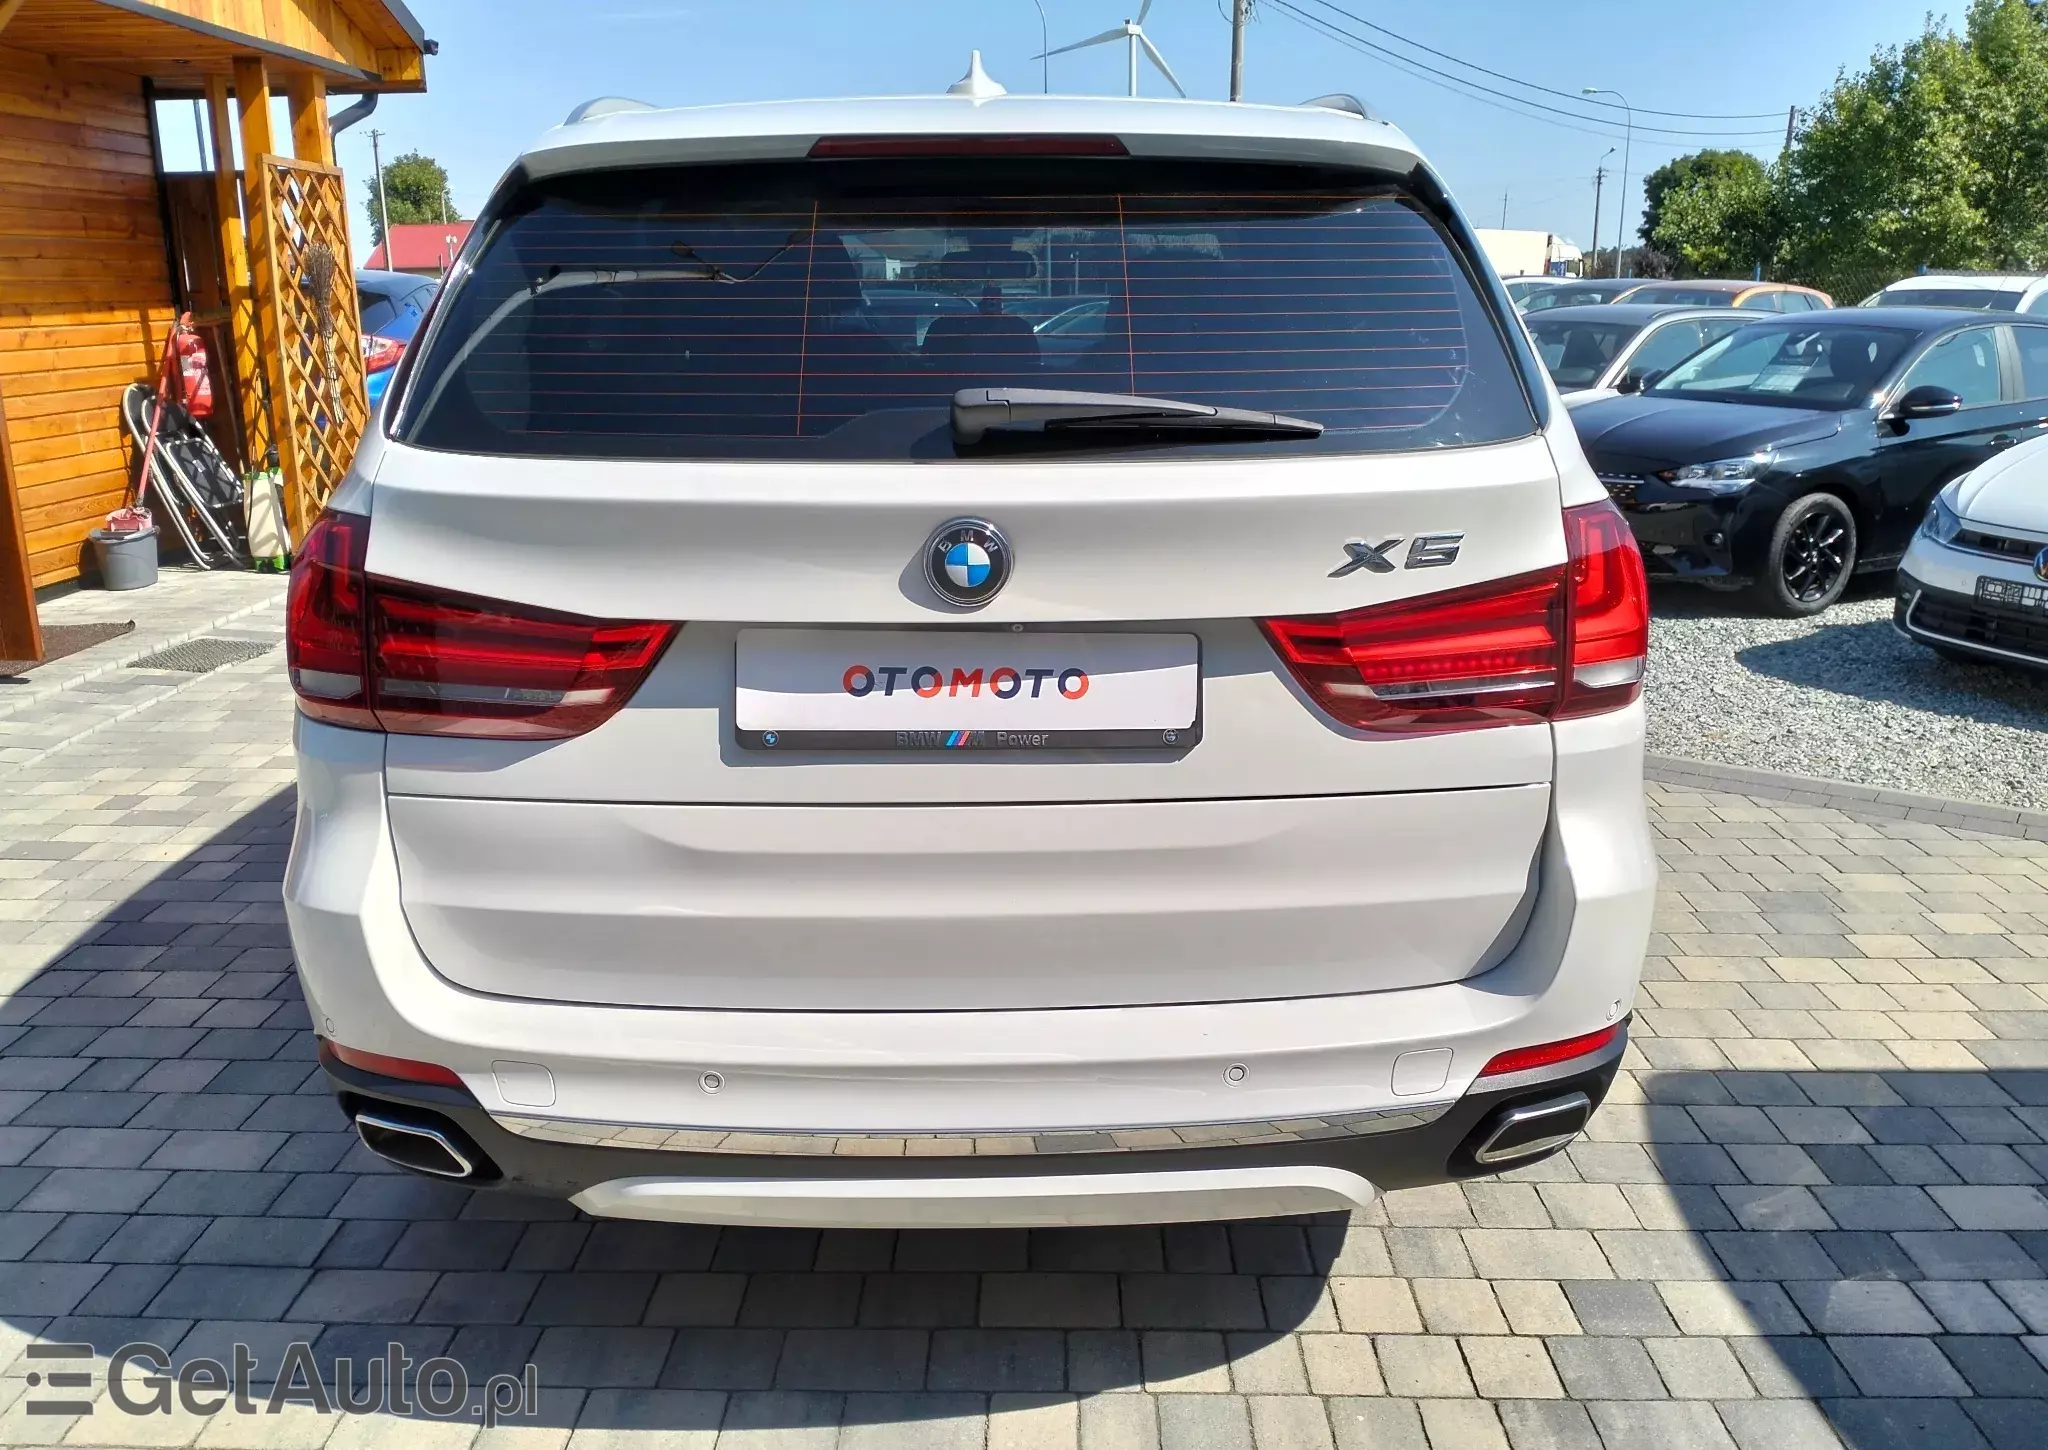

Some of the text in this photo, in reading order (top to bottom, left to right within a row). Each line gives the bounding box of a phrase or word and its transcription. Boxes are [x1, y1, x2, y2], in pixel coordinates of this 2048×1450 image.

[938, 530, 998, 553] BMW
[843, 665, 1090, 700] OTOMOTO
[896, 731, 942, 747] BMW
[996, 731, 1049, 746] Power
